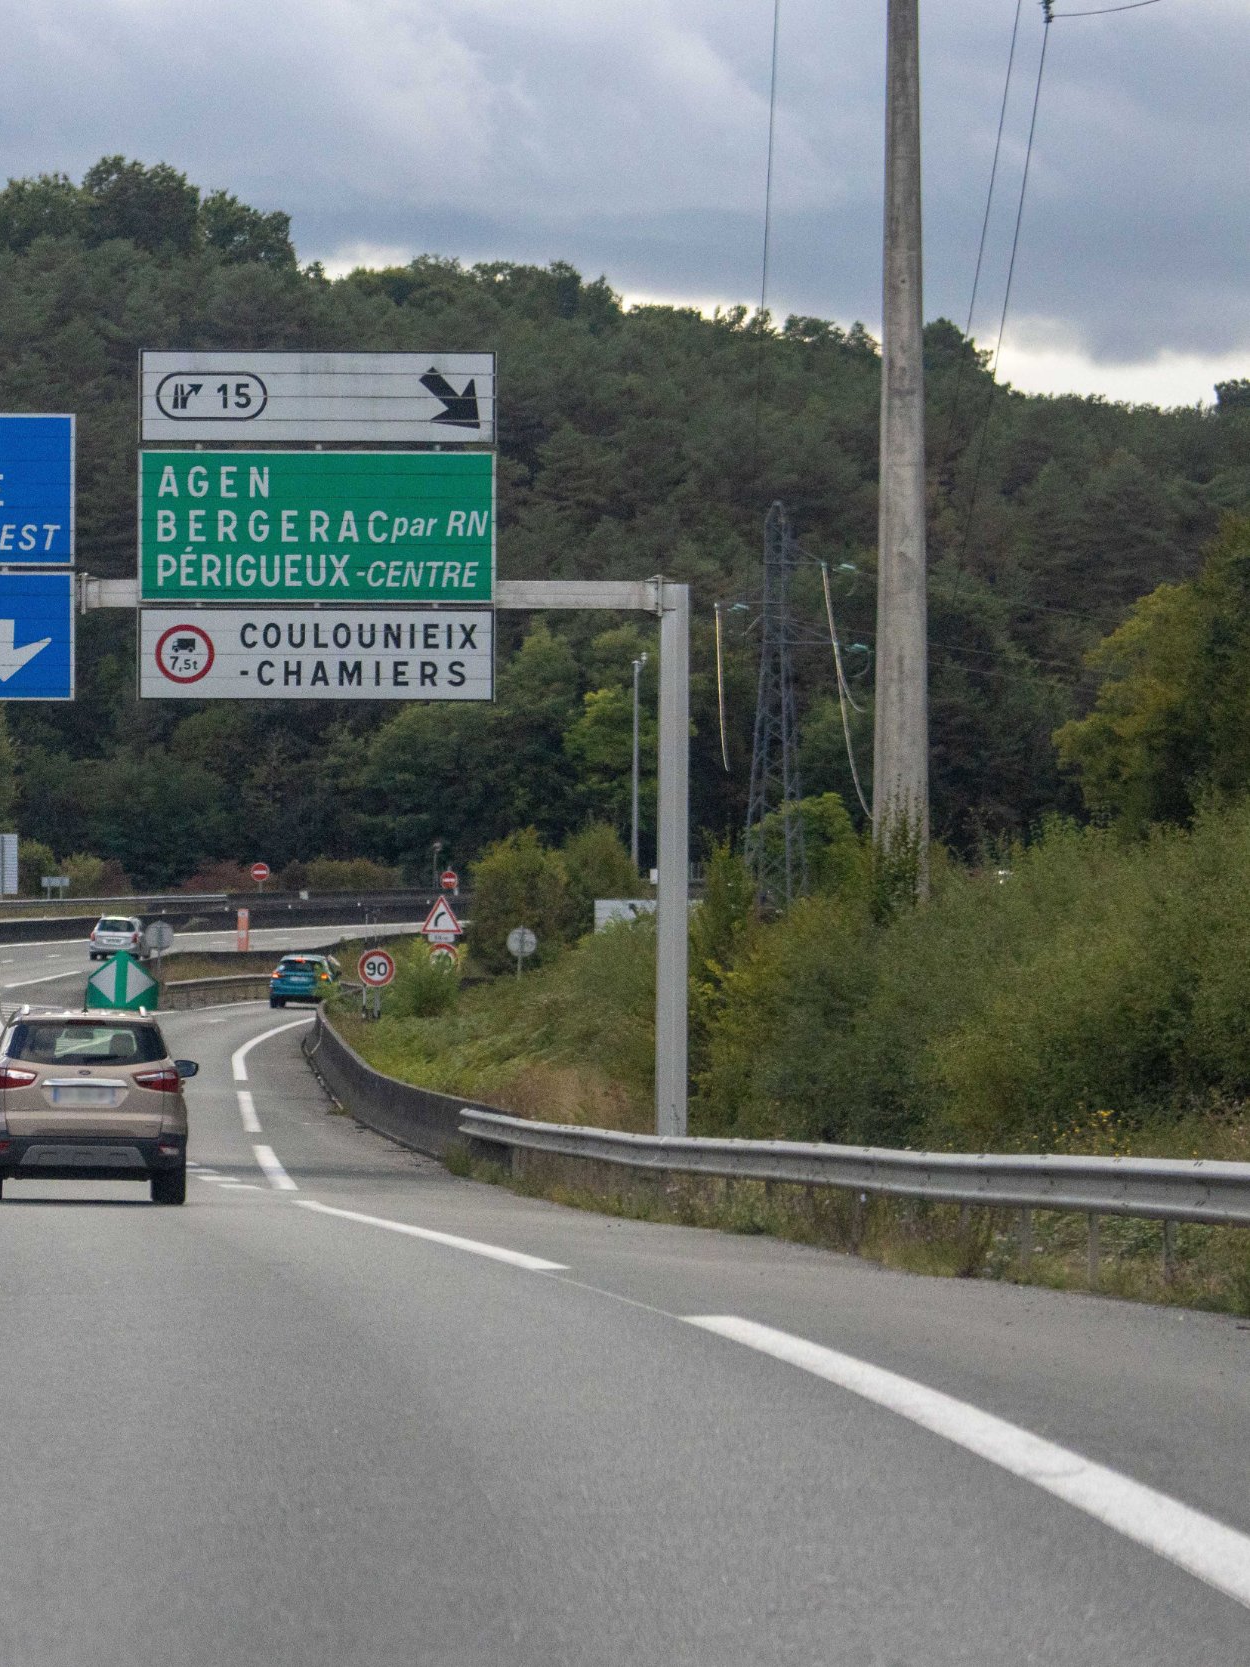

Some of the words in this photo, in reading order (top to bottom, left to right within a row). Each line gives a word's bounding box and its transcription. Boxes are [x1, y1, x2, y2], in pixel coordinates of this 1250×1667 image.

[217, 383, 252, 409] 15
[157, 465, 270, 499] AGEN
[156, 509, 389, 543] BERGERAC
[390, 518, 438, 544] par
[445, 510, 489, 537] RN
[157, 546, 351, 588] PÉRIGUEUX
[239, 622, 477, 650] COULOUNIEIX
[239, 660, 467, 687] -CHAMIERS
[366, 961, 388, 977] 90
